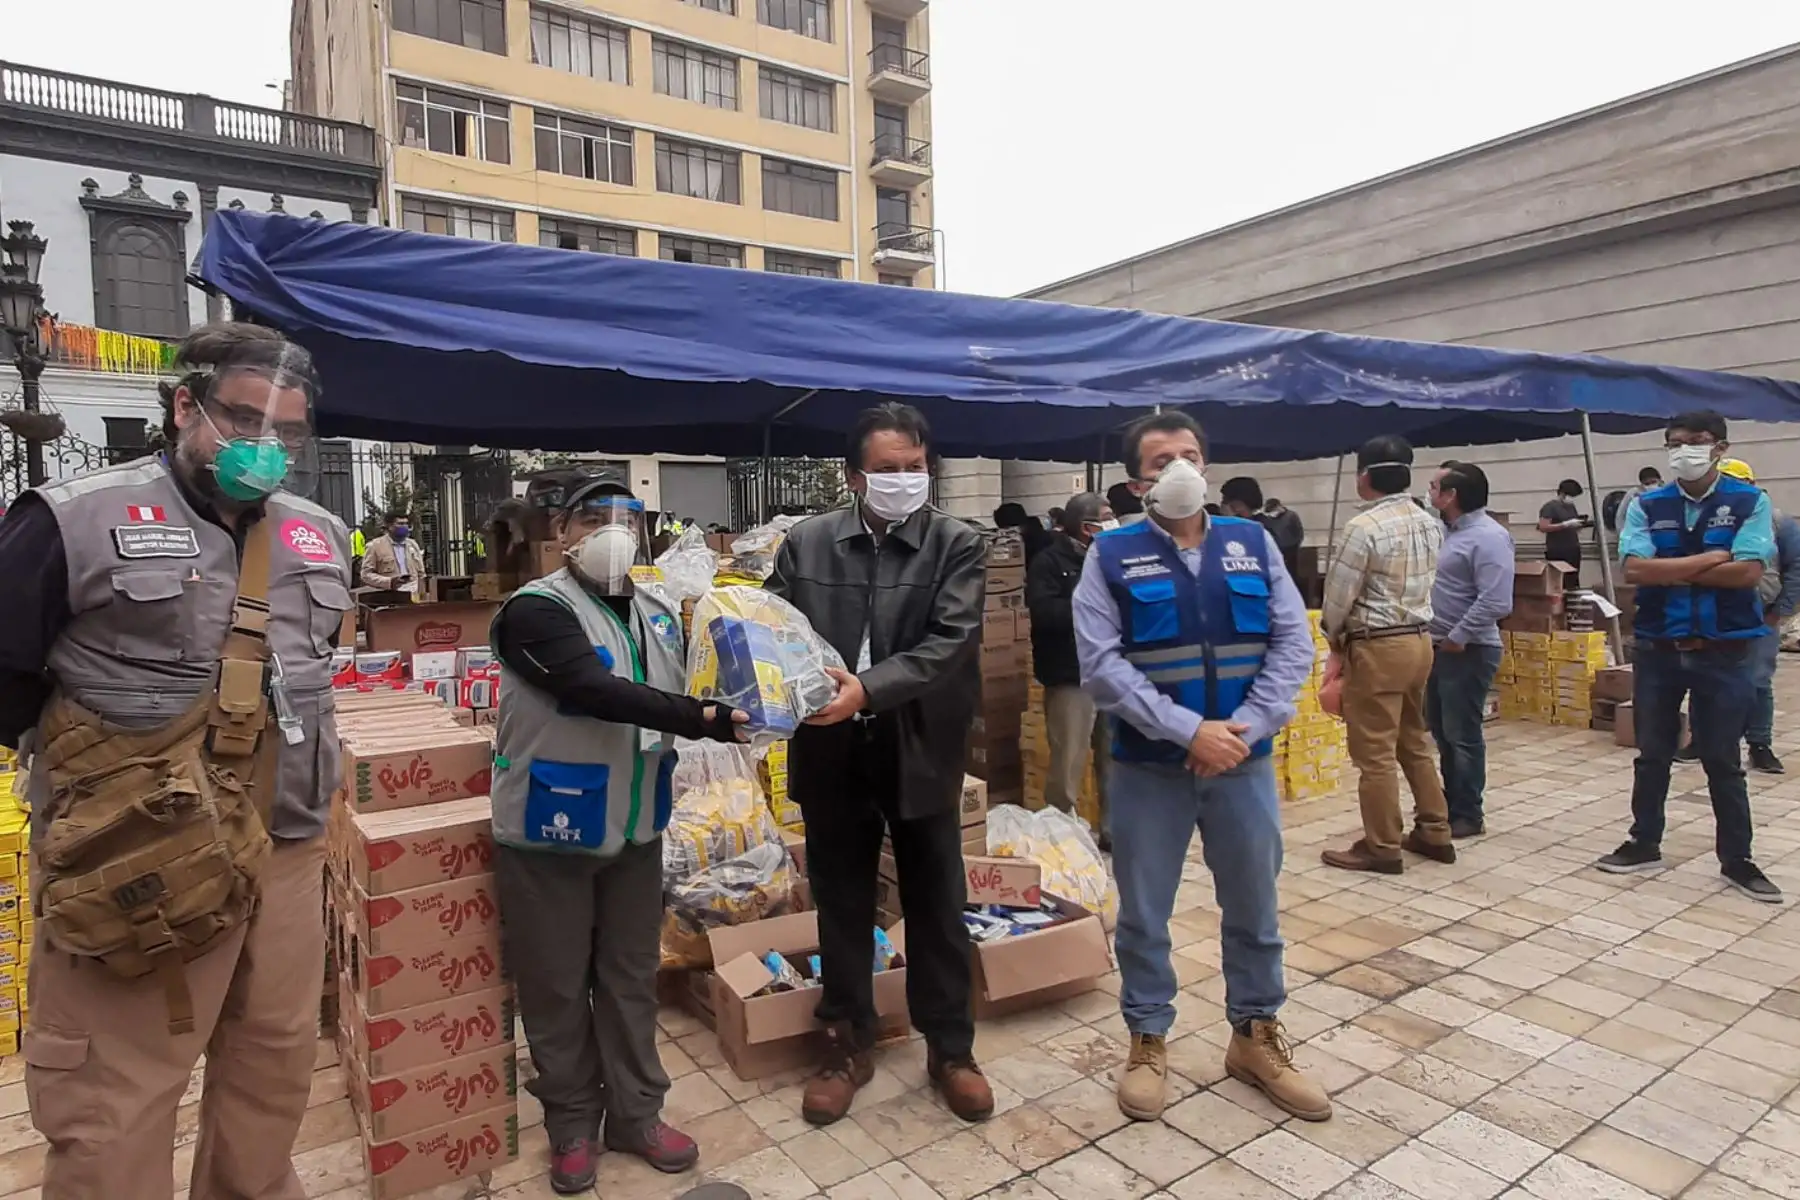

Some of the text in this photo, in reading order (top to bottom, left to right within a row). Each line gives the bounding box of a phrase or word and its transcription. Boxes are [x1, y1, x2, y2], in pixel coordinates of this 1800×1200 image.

[1223, 560, 1262, 572] LIMA
[377, 756, 433, 795] Pulp
[439, 893, 495, 933] Pulp
